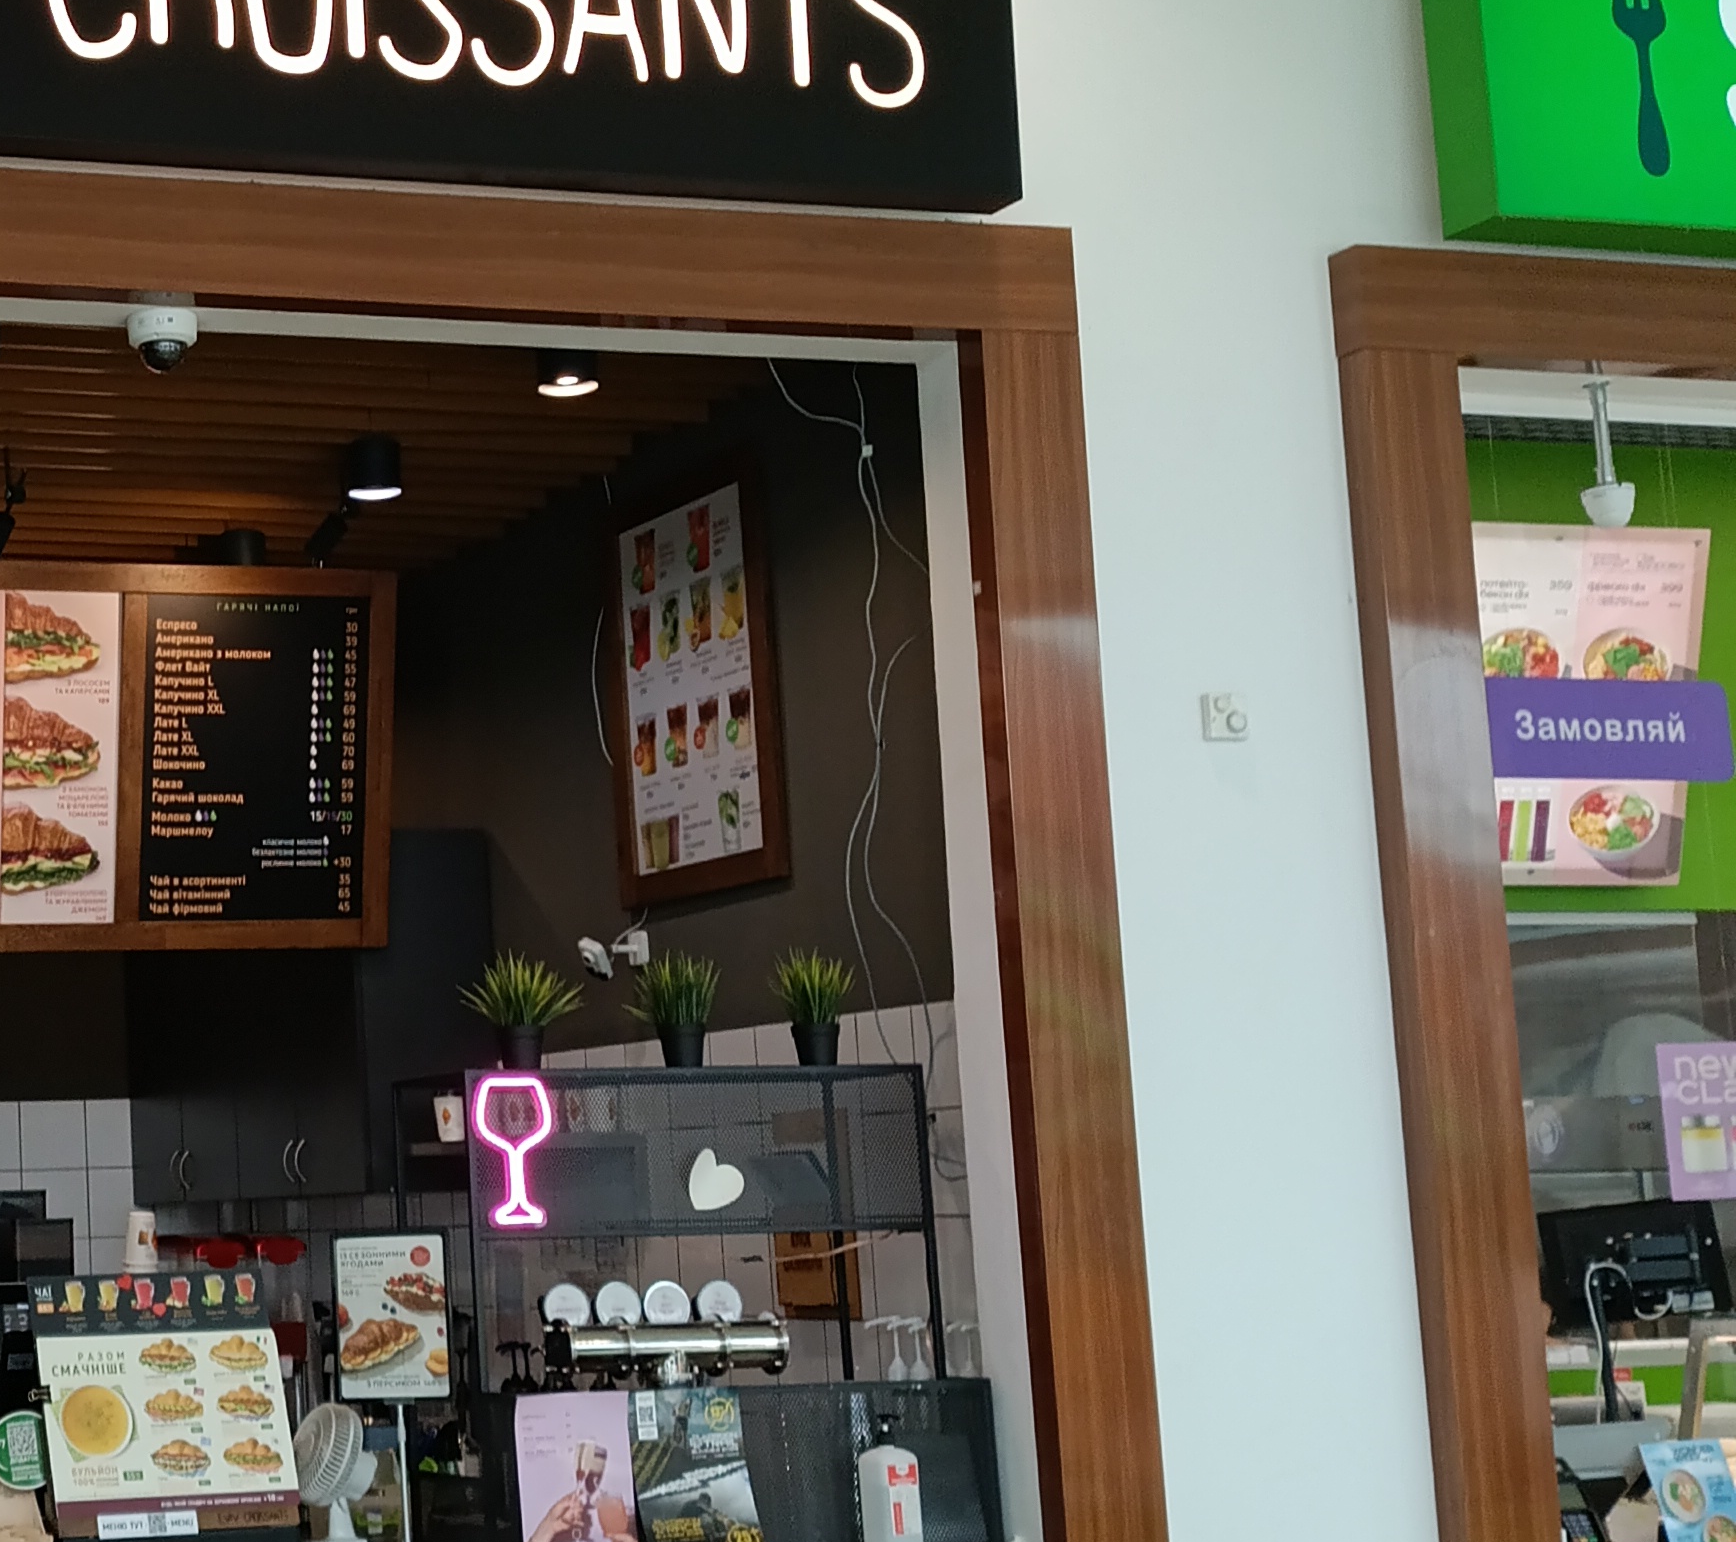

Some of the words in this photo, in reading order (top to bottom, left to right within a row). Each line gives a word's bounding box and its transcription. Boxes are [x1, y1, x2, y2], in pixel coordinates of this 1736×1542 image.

[216, 602, 258, 613] ГАРЯЧІ
[264, 603, 300, 613] НАПОЇ
[156, 618, 198, 632] Еспресо
[345, 622, 358, 633] 30
[155, 632, 214, 646] Американо
[345, 636, 358, 647] 39
[155, 647, 214, 660] Американо
[225, 650, 272, 660] молоком
[345, 649, 357, 660] 45
[155, 661, 183, 672] Флет
[185, 660, 211, 673] Вайт
[344, 663, 357, 674] 55
[154, 675, 205, 688] Капучино
[207, 676, 214, 686] L
[344, 676, 357, 688] 47
[154, 688, 205, 702] Капучино
[207, 689, 220, 700] XL
[344, 690, 357, 702] 59
[154, 702, 204, 716] Капучино
[206, 703, 226, 715] XXL
[343, 704, 356, 716] 69
[1515, 709, 1686, 743] Замовляй
[152, 759, 206, 771] Шокочино
[341, 759, 355, 770] 69
[152, 777, 184, 789] Какао
[341, 778, 354, 790] 59
[152, 791, 195, 804] Гарячий
[198, 793, 244, 804] шоколад
[341, 792, 354, 803] 59
[151, 811, 191, 822] Молоко
[151, 824, 214, 839] Маршмелоу
[341, 824, 352, 835] 17
[149, 888, 170, 900] Чай
[172, 888, 231, 900] вітамінний
[338, 887, 351, 899] 65
[149, 902, 170, 914] Чай
[172, 902, 223, 916] фірмовий
[338, 901, 350, 913] 45
[77, 1351, 125, 1362] РАЗОМ
[51, 1363, 127, 1378] СМАЧНІШЕ
